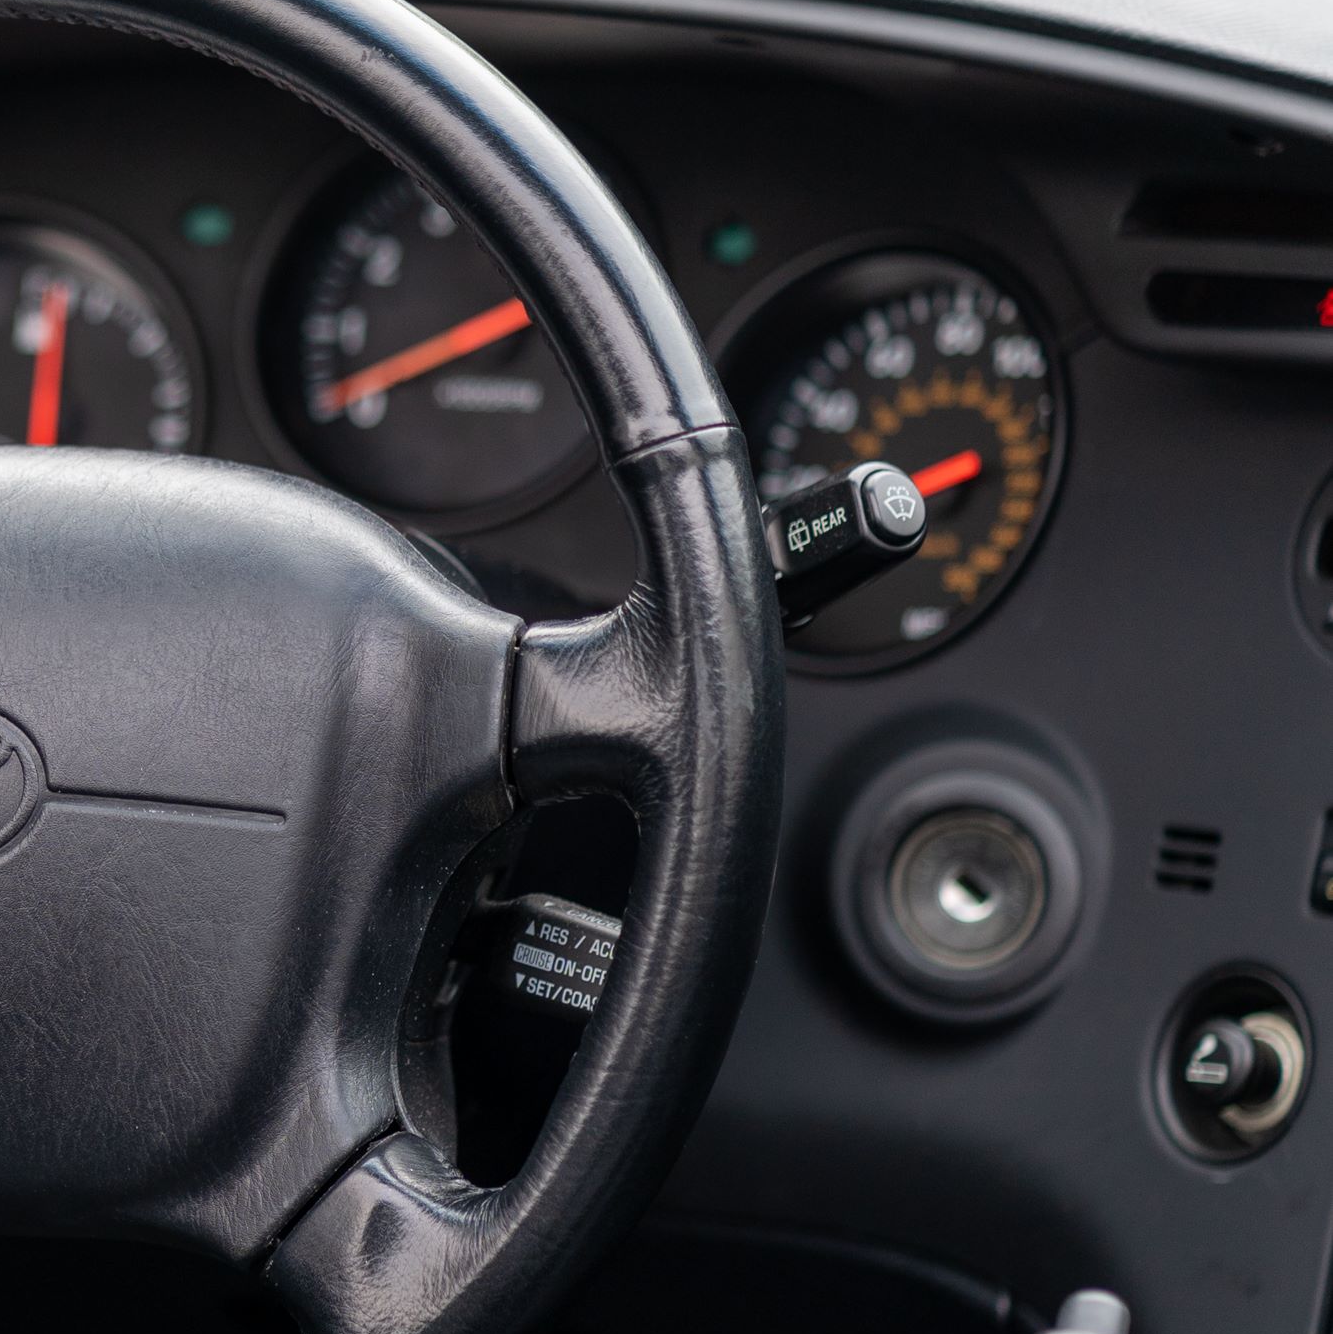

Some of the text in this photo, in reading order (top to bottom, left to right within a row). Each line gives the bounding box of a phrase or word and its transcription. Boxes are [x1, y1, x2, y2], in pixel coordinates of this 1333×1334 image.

[811, 507, 847, 537] REAR
[539, 923, 569, 945] RES
[516, 944, 553, 970] CRUISE
